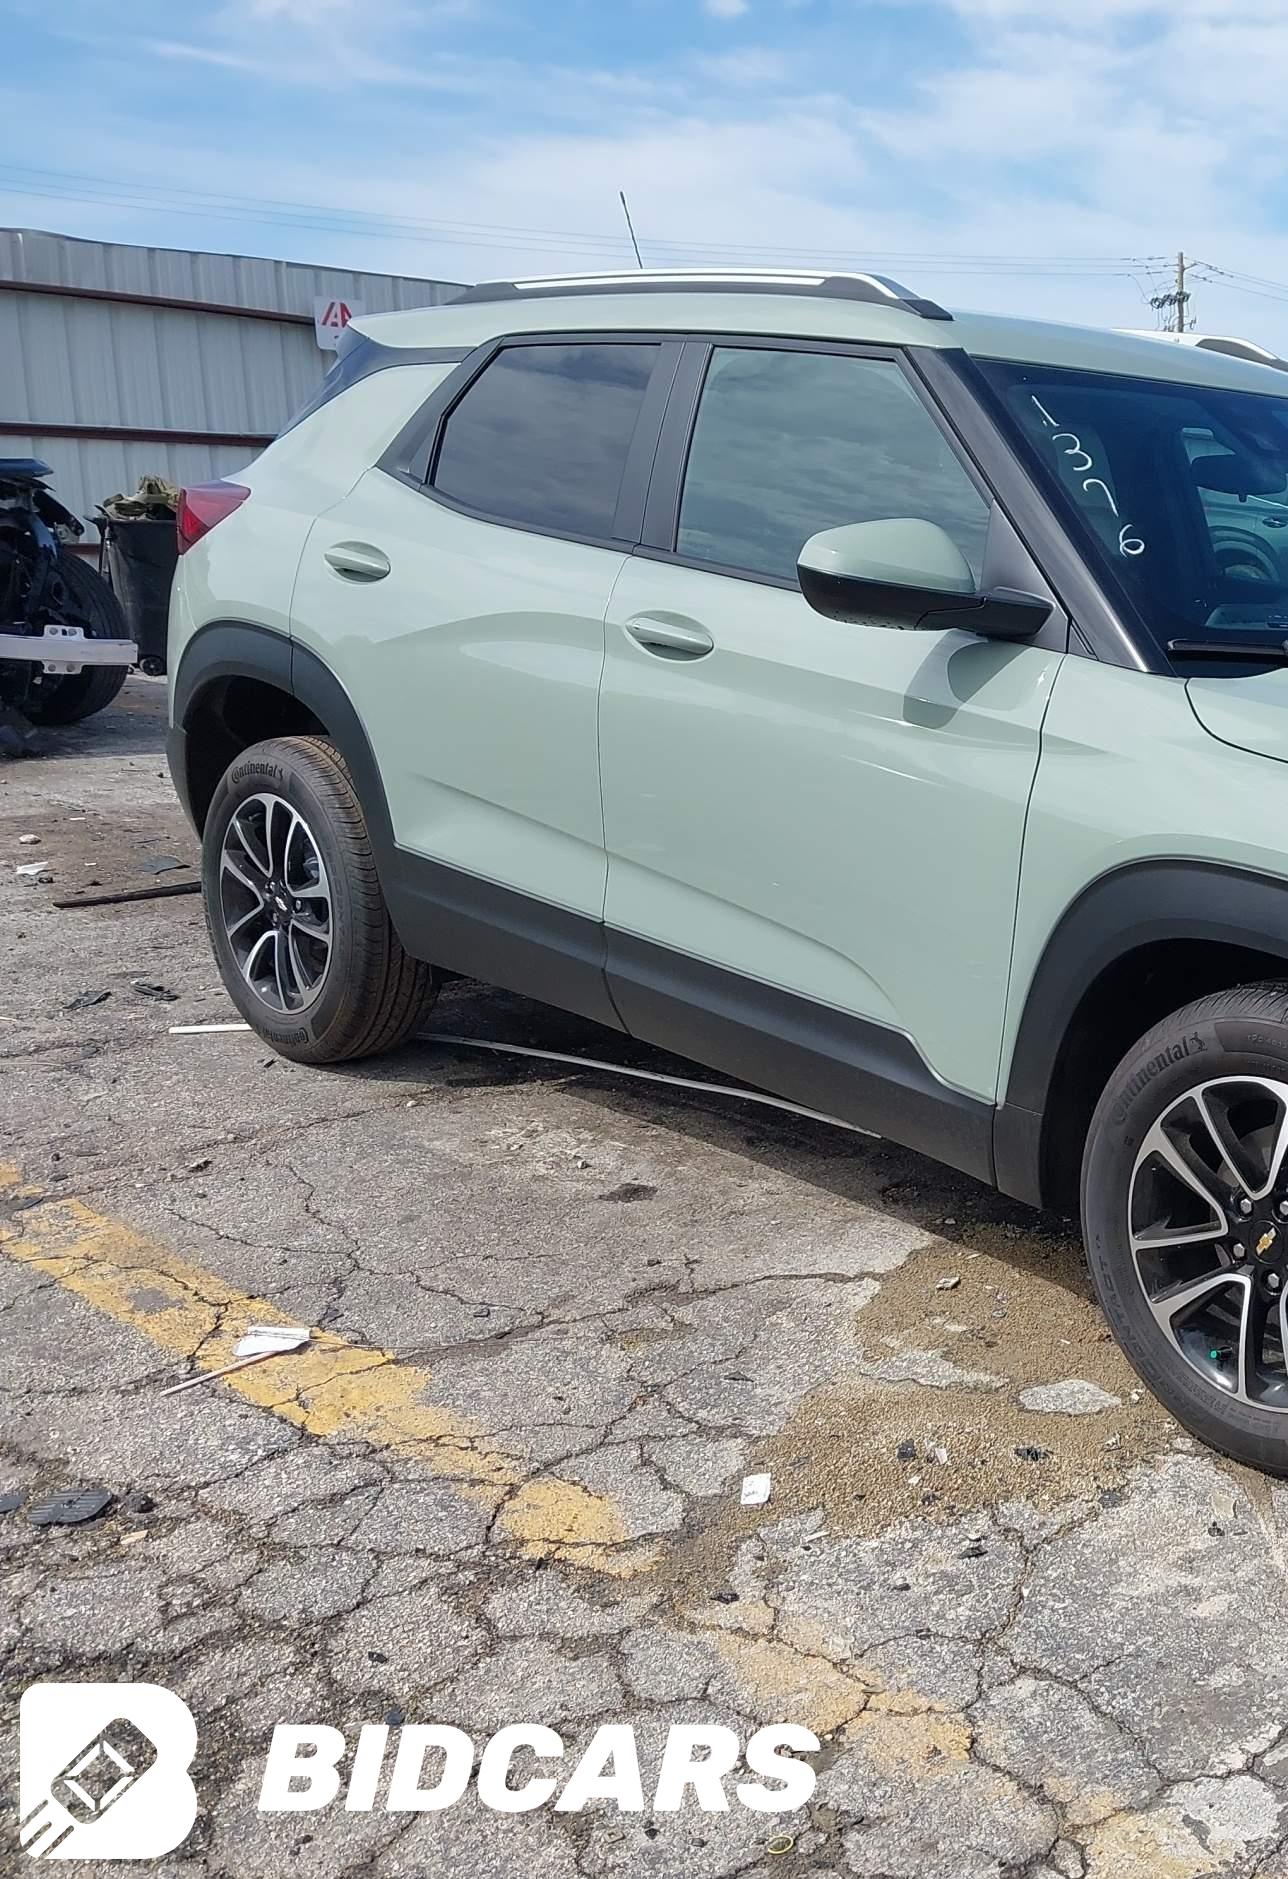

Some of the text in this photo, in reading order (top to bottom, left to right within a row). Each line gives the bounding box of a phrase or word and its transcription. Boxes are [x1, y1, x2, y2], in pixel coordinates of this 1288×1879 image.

[1032, 395, 1145, 558] 1376
[231, 760, 278, 784] Continental
[1111, 1035, 1190, 1126] Continental
